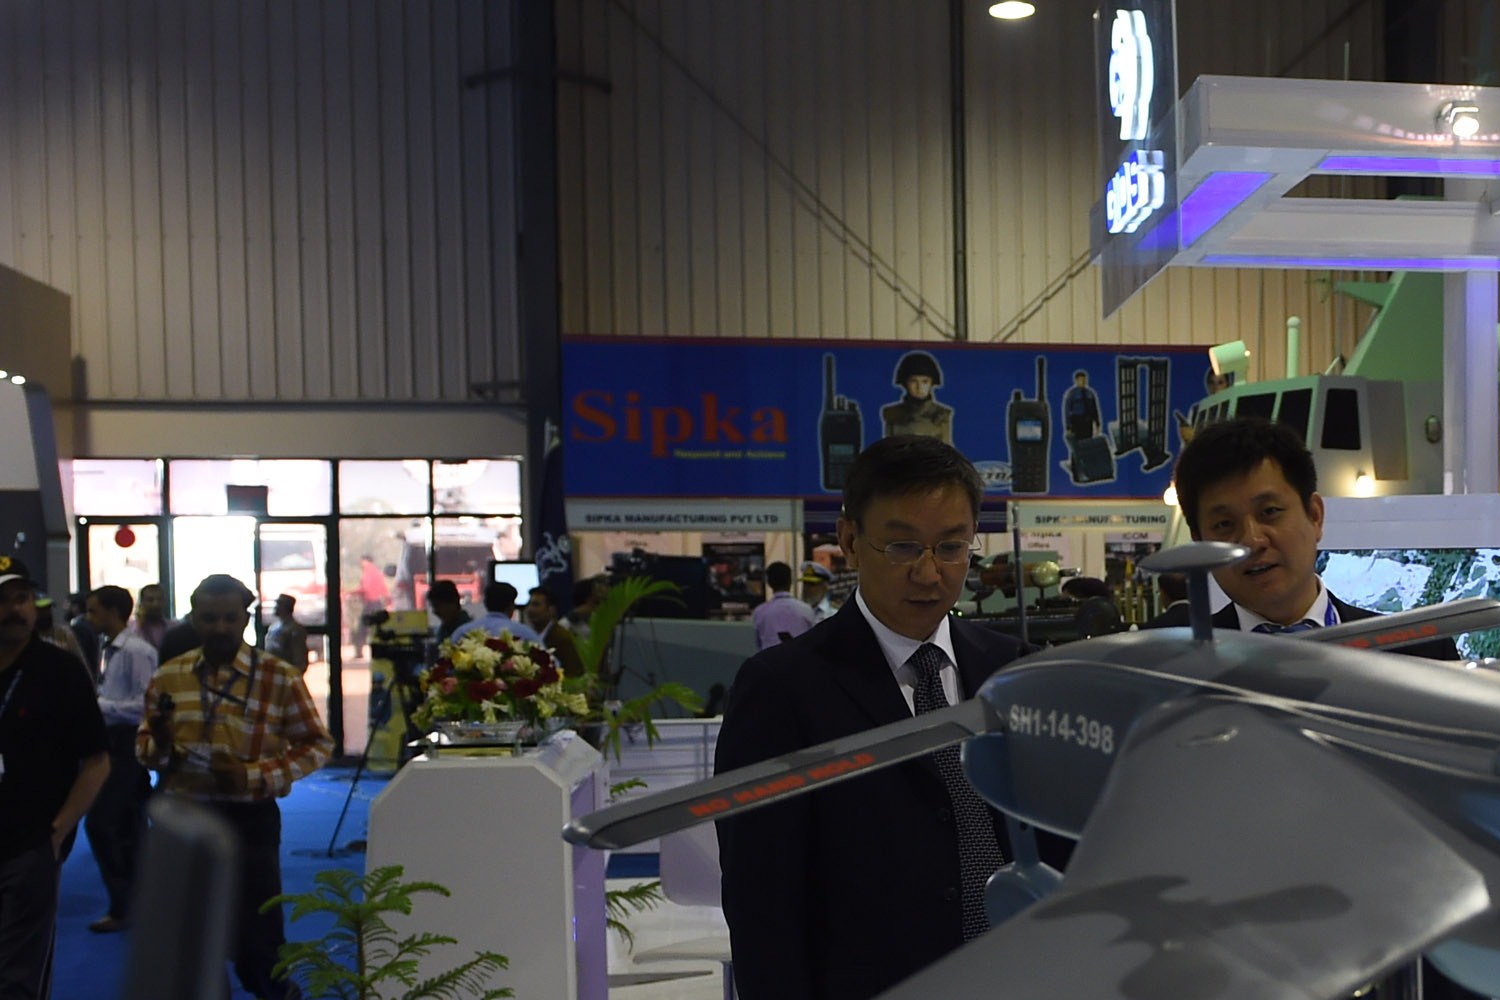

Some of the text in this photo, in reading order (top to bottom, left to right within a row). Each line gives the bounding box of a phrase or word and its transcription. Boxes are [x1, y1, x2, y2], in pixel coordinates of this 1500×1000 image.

[571, 389, 788, 458] Sipka
[585, 514, 779, 525] SIPKA MANUFACTURING PVT LTD
[690, 752, 876, 818] NO HAND HOLD
